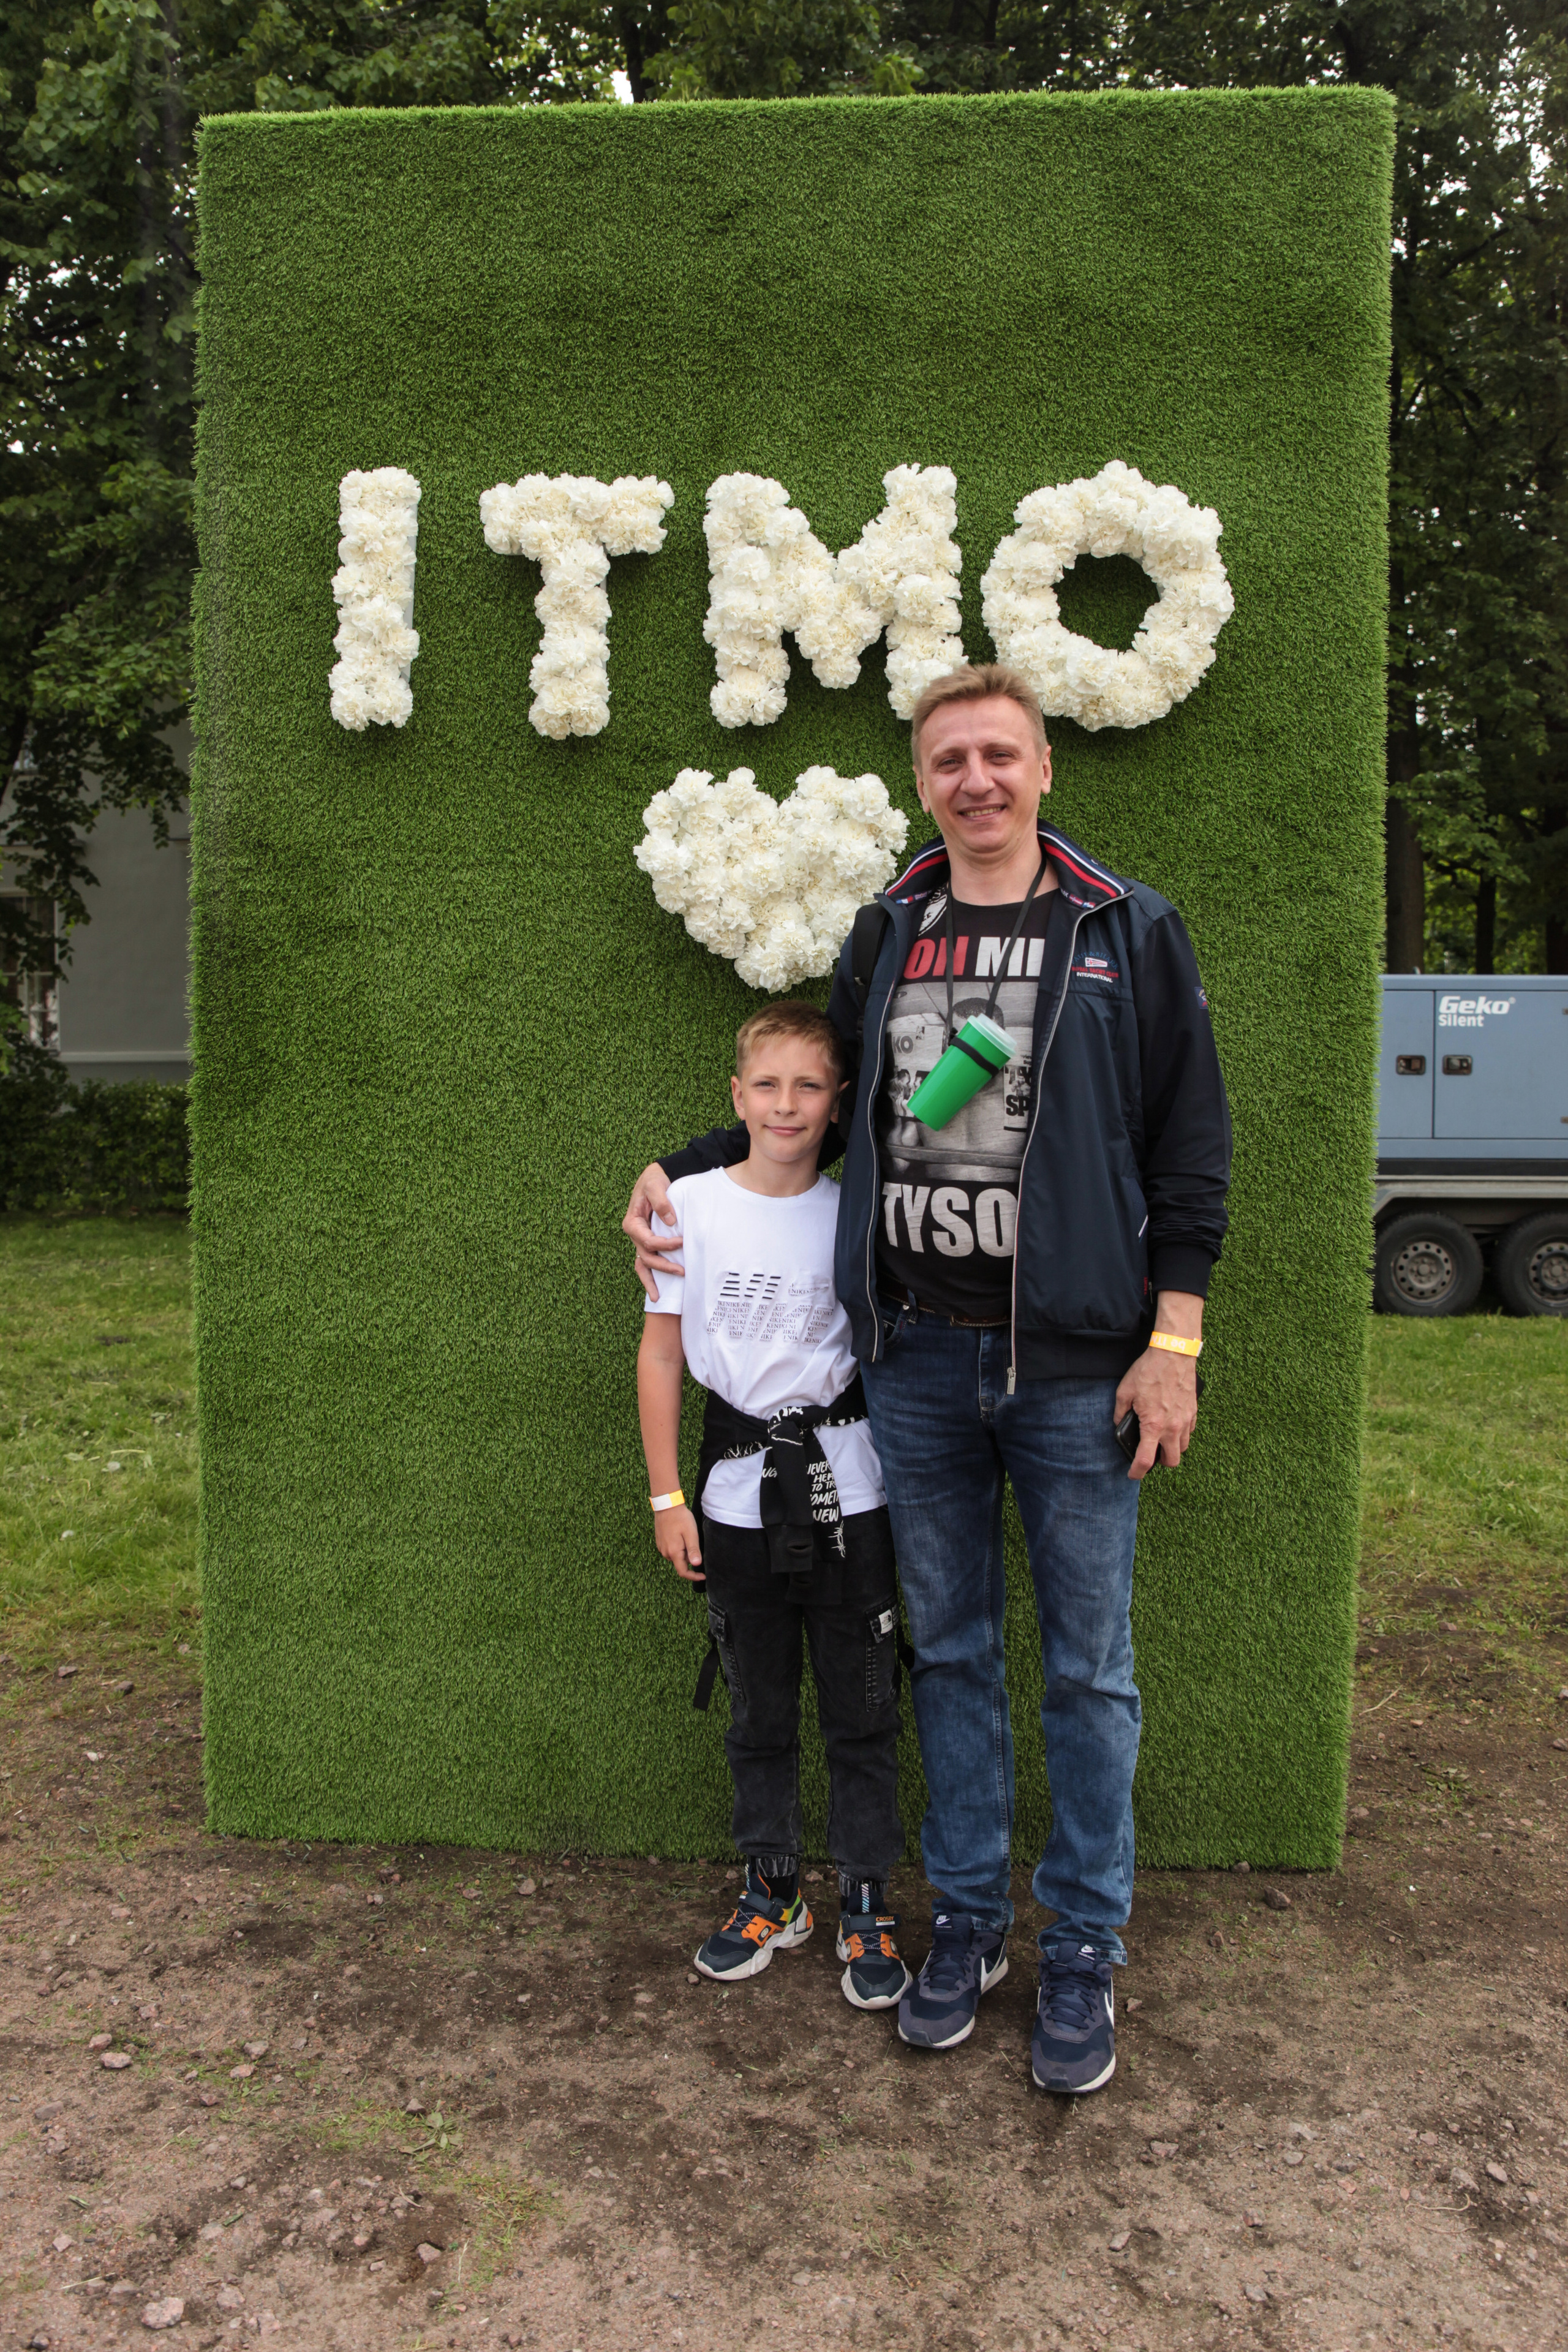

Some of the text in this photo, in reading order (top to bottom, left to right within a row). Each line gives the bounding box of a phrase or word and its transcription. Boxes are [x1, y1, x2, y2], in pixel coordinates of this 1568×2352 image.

[329, 459, 1234, 740] ITMO
[1076, 971, 1114, 983] INTERNATIONAL
[1438, 1014, 1485, 1027] Silent
[812, 1483, 823, 1492] TO
